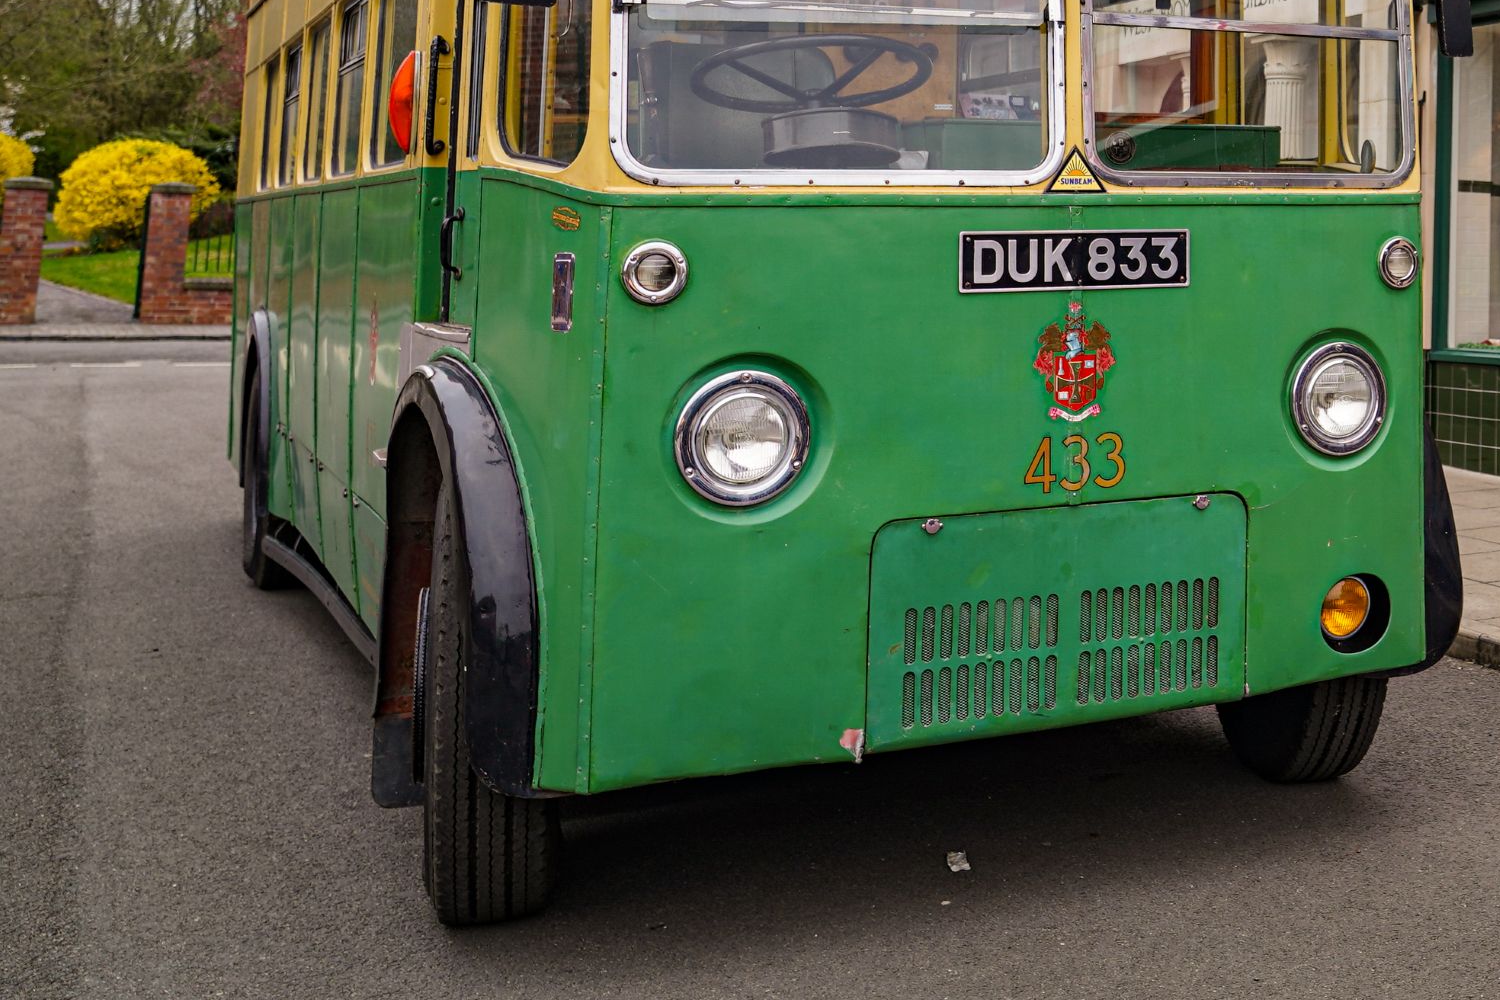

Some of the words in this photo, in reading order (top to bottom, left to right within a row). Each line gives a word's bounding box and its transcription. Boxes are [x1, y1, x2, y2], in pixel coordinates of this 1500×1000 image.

[1060, 177, 1093, 185] SUNBEAM
[973, 238, 1074, 284] DUK
[1087, 237, 1179, 281] 833
[1024, 431, 1127, 494] 433
